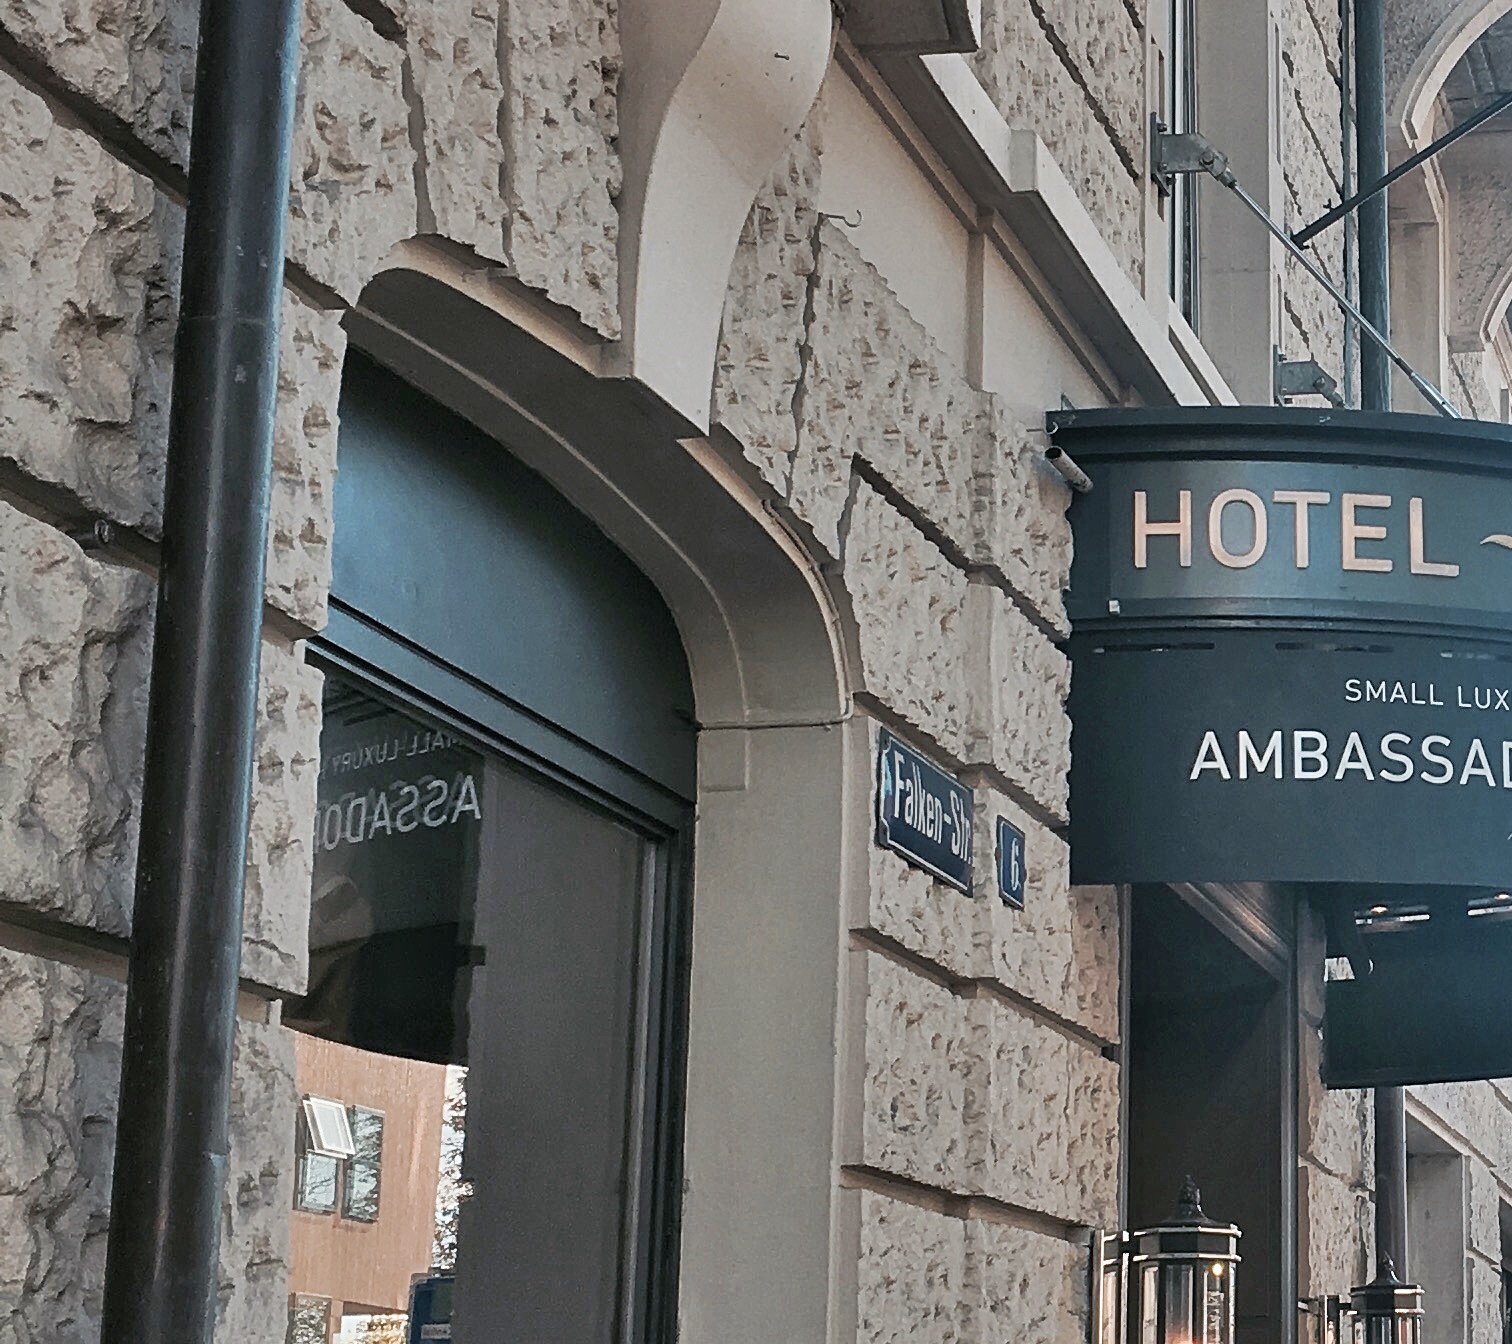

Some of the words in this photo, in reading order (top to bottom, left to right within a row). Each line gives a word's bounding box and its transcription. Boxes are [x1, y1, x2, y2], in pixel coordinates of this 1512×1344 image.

[1132, 487, 1460, 578] HOTEL
[1344, 678, 1445, 707] SMALL
[1009, 837, 1022, 892] 6
